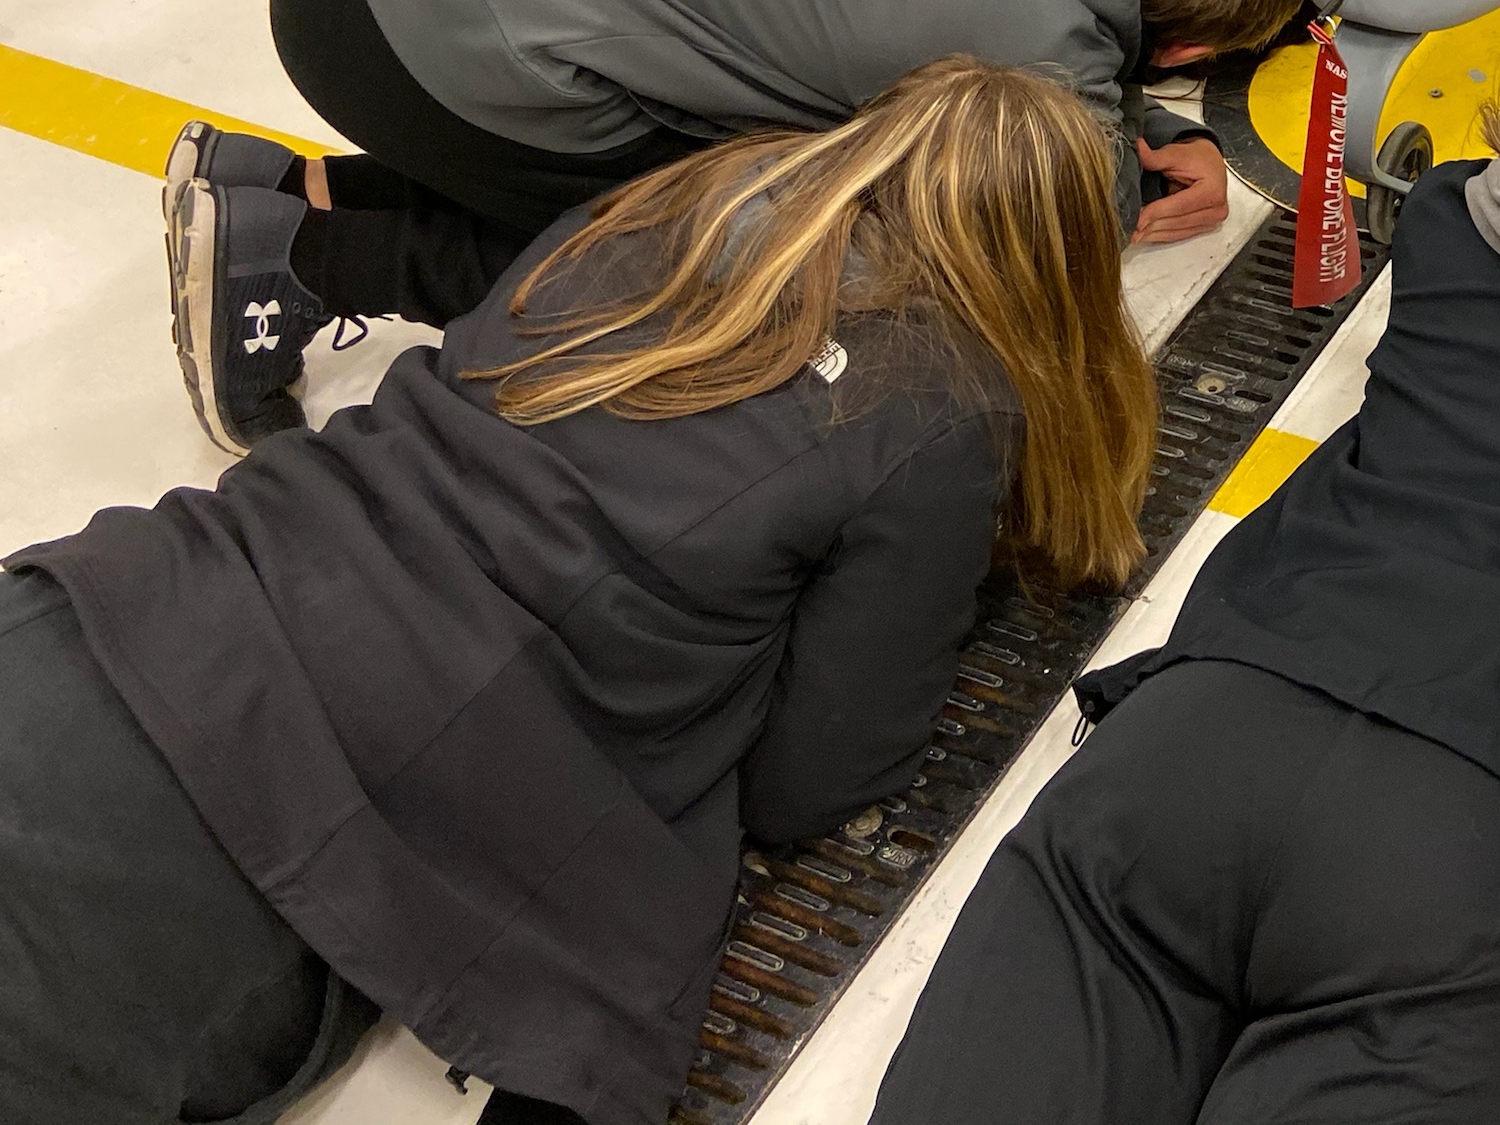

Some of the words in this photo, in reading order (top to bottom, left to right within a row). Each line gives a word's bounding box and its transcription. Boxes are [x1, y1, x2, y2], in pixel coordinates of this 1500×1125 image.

[1327, 92, 1349, 163] REMOVE
[1322, 166, 1346, 230] BEFORE
[1320, 231, 1347, 283] FLIGHT
